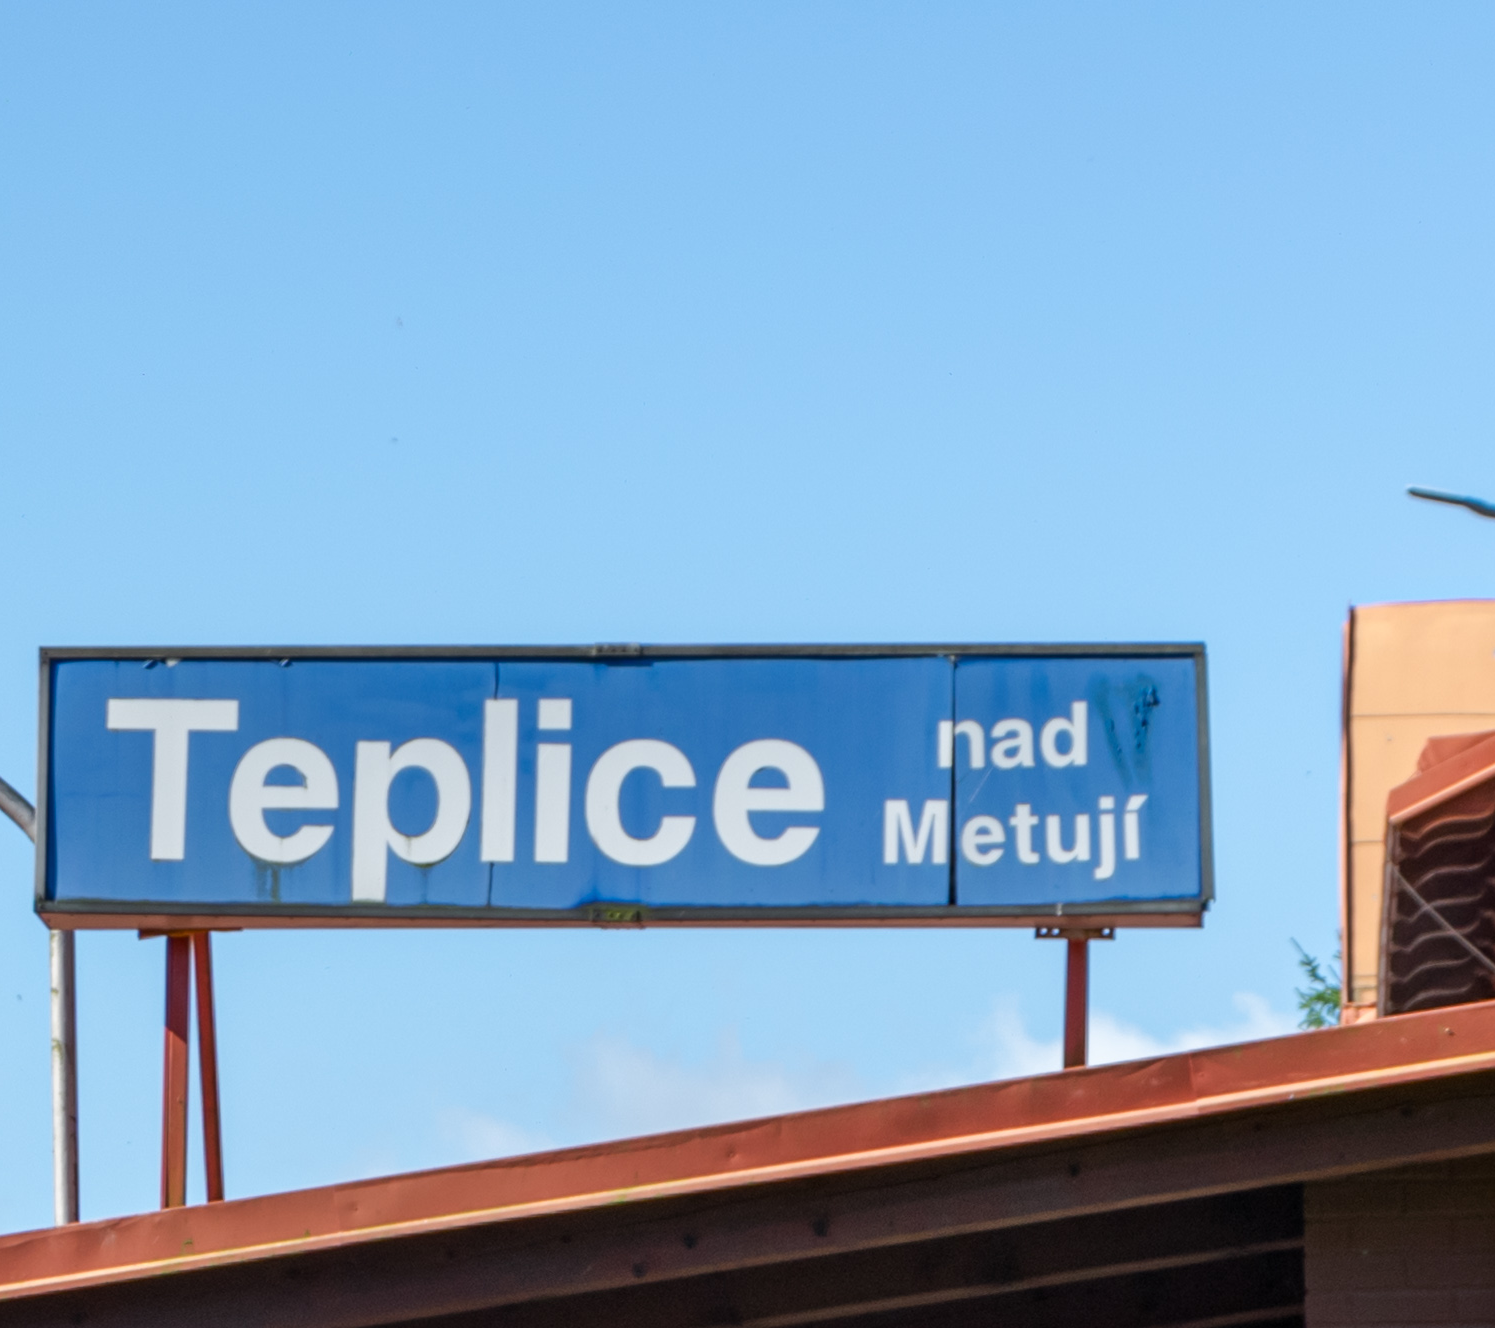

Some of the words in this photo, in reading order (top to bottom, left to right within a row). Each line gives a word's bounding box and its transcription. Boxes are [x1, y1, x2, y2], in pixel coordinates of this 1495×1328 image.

[937, 700, 1088, 770] nad
[106, 698, 825, 902] Teplice
[882, 794, 1149, 880] Metují
